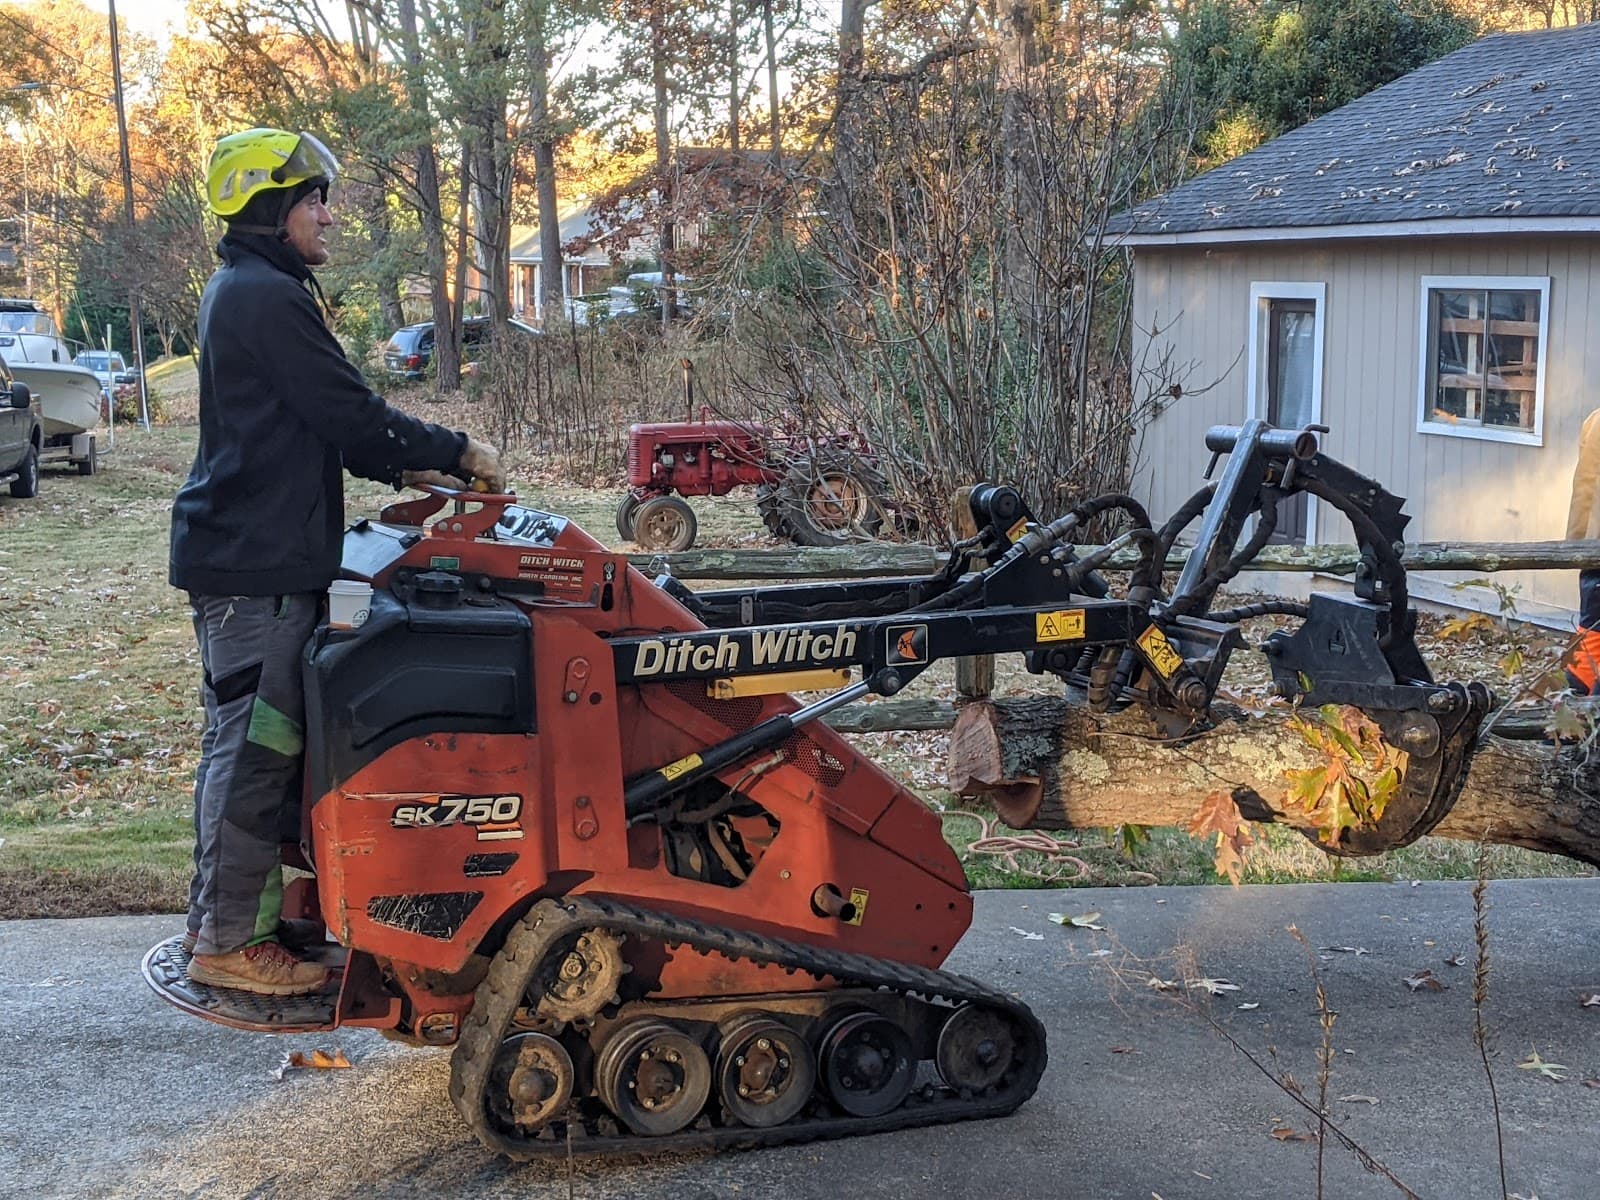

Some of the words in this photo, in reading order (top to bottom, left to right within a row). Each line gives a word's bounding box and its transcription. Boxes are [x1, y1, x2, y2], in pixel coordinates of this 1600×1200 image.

[520, 556, 550, 565] DITCH
[553, 558, 584, 568] WITCH
[633, 634, 741, 677] Ditch
[752, 624, 857, 666] Witch
